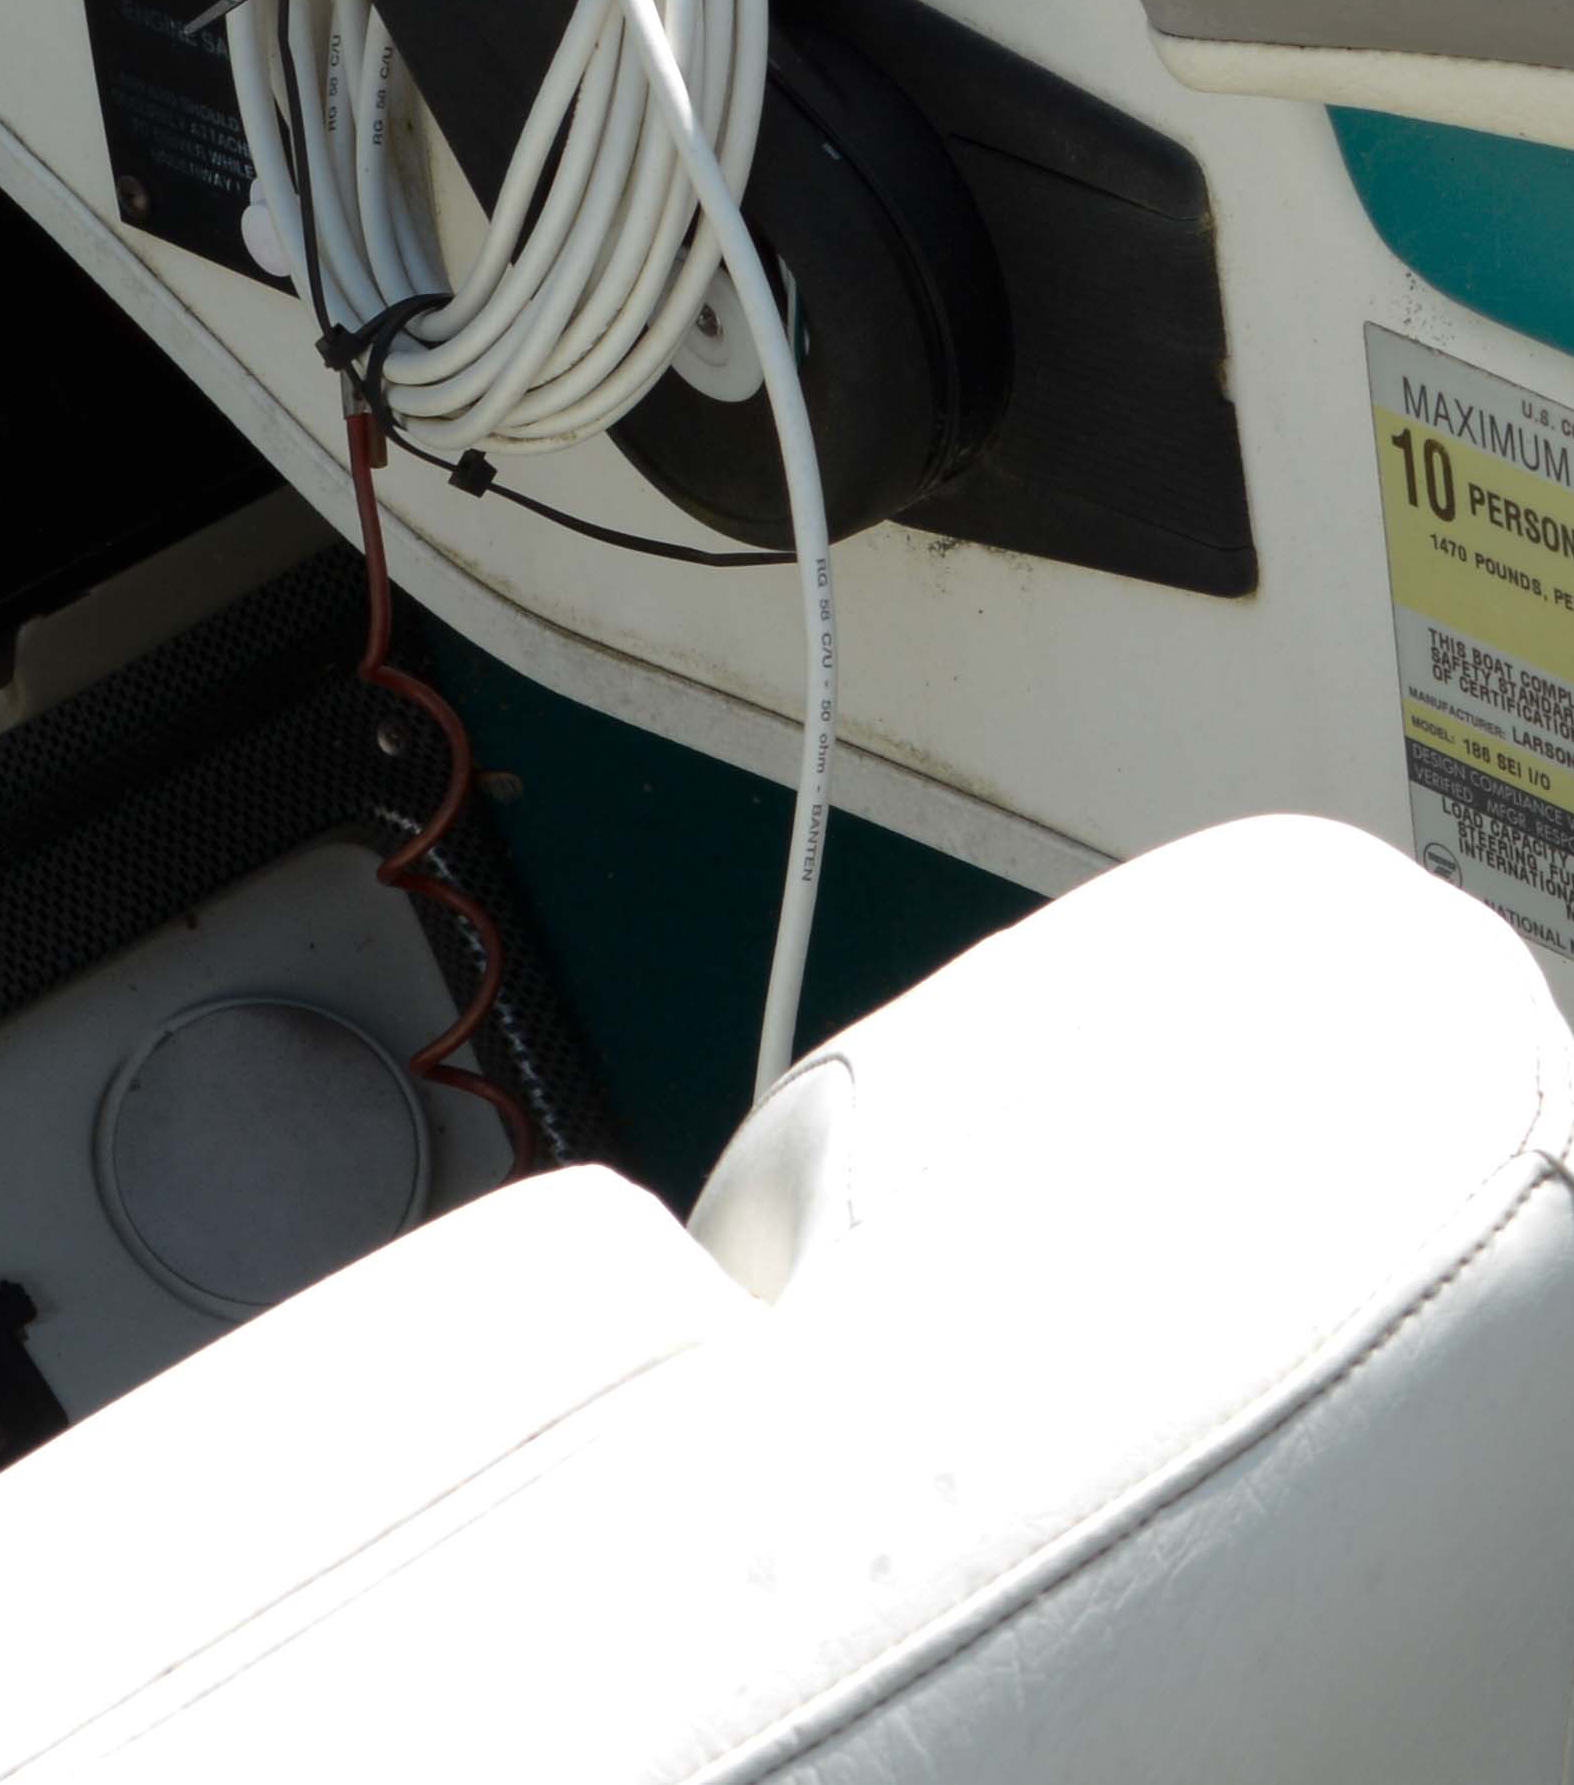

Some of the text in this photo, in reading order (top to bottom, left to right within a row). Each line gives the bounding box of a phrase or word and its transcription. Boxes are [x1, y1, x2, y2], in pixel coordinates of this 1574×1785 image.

[1400, 373, 1571, 489] MAXIMUM
[1521, 399, 1555, 432] U.S.
[1389, 418, 1458, 528] 10
[1429, 530, 1468, 565] 1470
[1473, 550, 1549, 604] POUNDS,
[1428, 626, 1467, 661] THIS
[1470, 645, 1514, 682] BOAT
[1429, 643, 1492, 689] SAFETY
[1431, 661, 1453, 688] OF
[817, 734, 830, 774] ohm
[1411, 740, 1466, 782] DESIGN
[1468, 767, 1564, 827] COMPLIANCE
[802, 803, 823, 882] BANTEN
[1440, 793, 1484, 832] LOAD
[1488, 816, 1570, 871] CAPACITY
